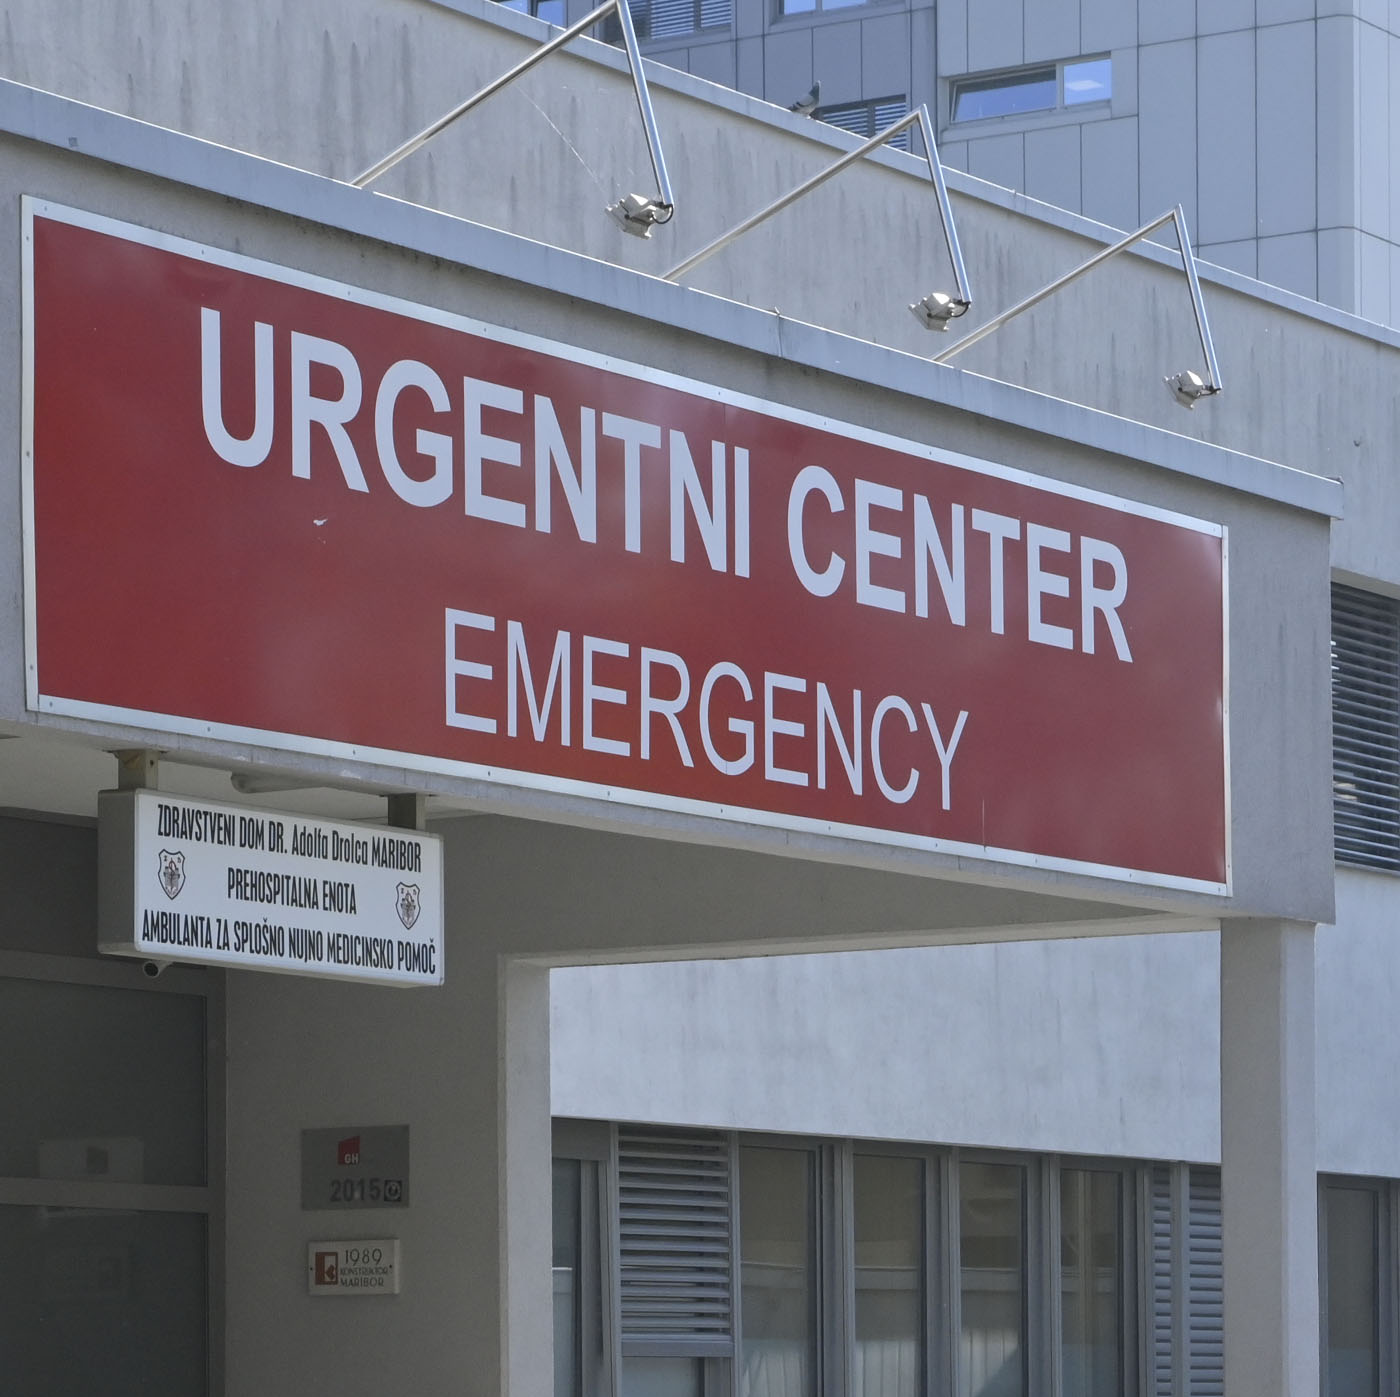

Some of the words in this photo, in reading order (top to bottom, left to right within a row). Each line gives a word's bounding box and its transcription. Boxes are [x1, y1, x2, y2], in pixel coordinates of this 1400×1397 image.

[201, 307, 749, 578] URGENTNI
[788, 466, 1133, 663] CENTER
[445, 608, 968, 810] EMERGENCY
[157, 803, 235, 847] ZDRAVSTVENI
[239, 818, 265, 851] DOM
[268, 823, 288, 855] DR.
[291, 827, 328, 861] Adolfa
[332, 830, 368, 866] Drolca
[371, 836, 422, 873] MARIBOR
[227, 867, 319, 911] PREHOSPITALNA
[322, 880, 357, 914] ENOTA
[142, 909, 213, 949] AMBULANTA
[216, 919, 230, 951] ZA
[234, 917, 285, 958] SPLOŠNO
[288, 927, 323, 963] NUJNO
[326, 932, 394, 970] MEDICINSKO
[397, 937, 436, 974] POMOČ
[340, 1277, 385, 1288] MARIBOR
[344, 1248, 383, 1267] 1989
